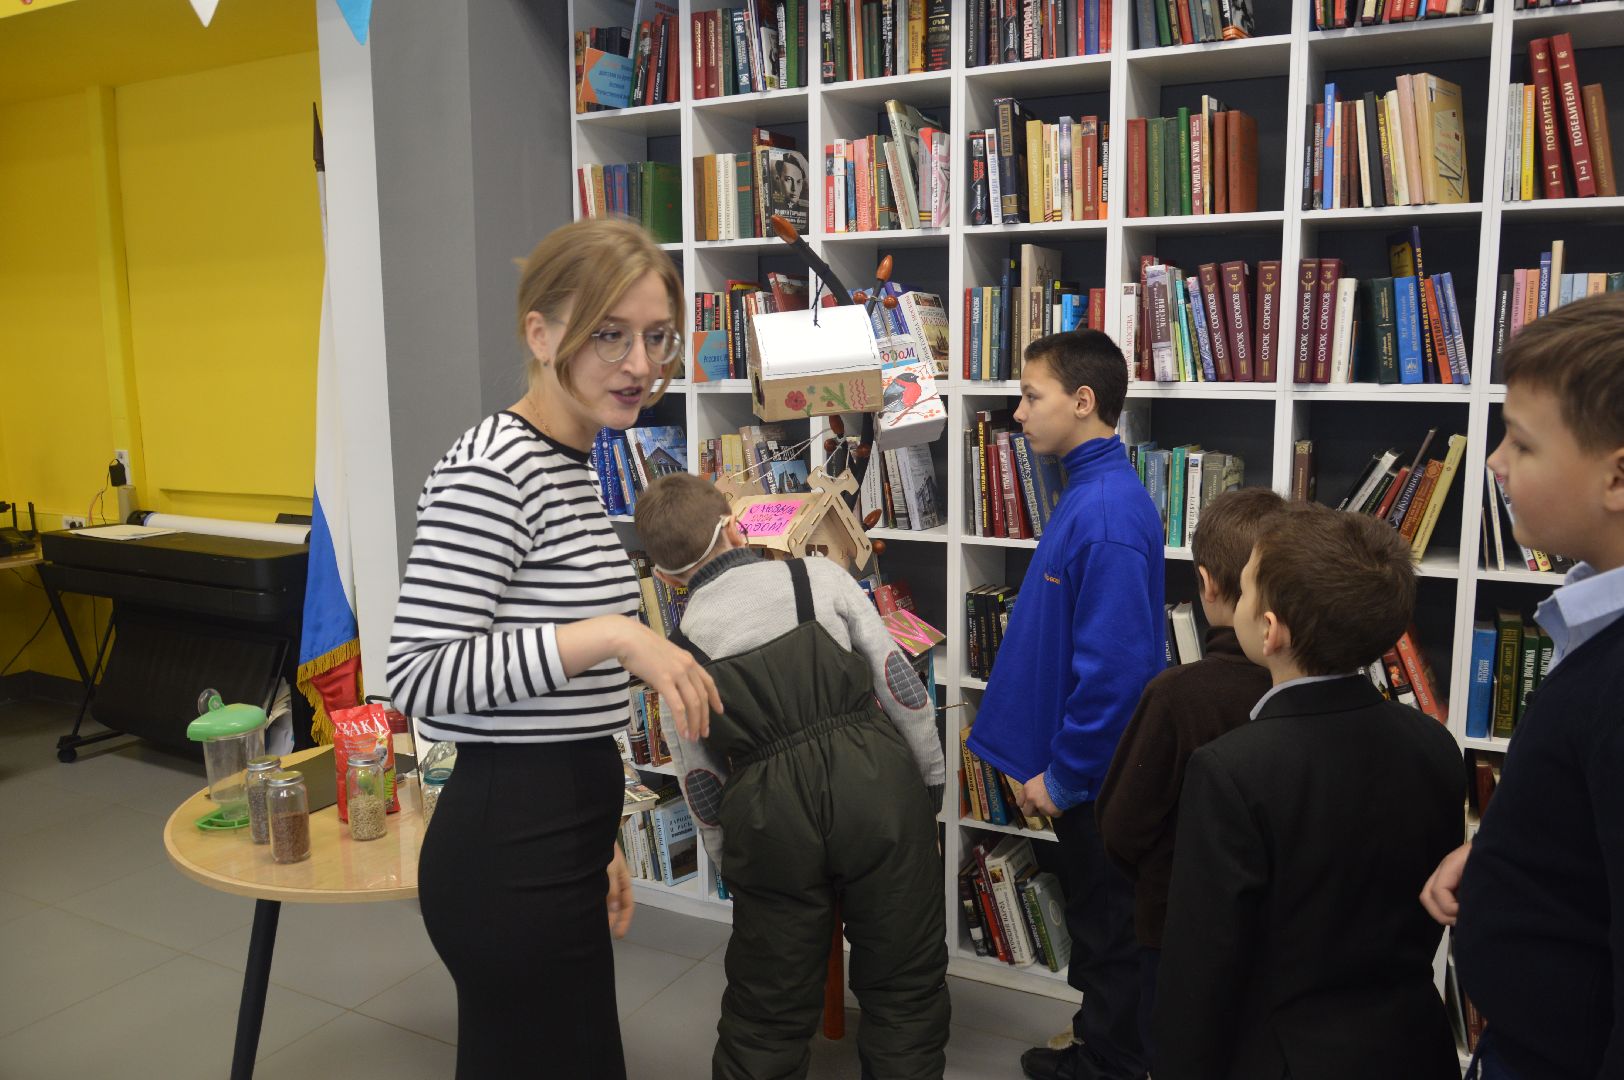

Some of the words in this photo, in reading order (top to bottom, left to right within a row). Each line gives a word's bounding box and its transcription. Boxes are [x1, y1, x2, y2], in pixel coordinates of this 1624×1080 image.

[1023, 6, 1033, 59] КАТАСТРОФА
[1540, 86, 1556, 151] ПОБЕДИТЕЛИ
[1563, 81, 1584, 147] ПОБЕДИТЕЛИ
[1192, 141, 1200, 163] ЖУКОВ
[1192, 165, 1201, 194] МАРШАЛ
[1551, 171, 1557, 180] 1
[1580, 166, 1587, 175] 2
[1209, 293, 1218, 329] СОРОКОВ
[1234, 293, 1242, 329] СОРОКОВ
[1263, 293, 1272, 330] СОРОКОВ
[1302, 292, 1312, 330] СОРОКОВ
[1320, 292, 1331, 330] СОРОКОВ
[1418, 271, 1429, 330] ВИДНОВСКОГО
[1539, 290, 1548, 308] ГОРОД
[1126, 314, 1134, 347] МОСКВА
[1213, 332, 1225, 359] СОРОК
[1237, 332, 1246, 359] СОРОК
[1262, 333, 1270, 361] СОРОК
[1300, 334, 1309, 361] СОРОК
[1318, 334, 1328, 362] СОРОК
[1424, 332, 1433, 363] АЗБУКА
[1447, 334, 1459, 375] БАЛАШИХА
[1457, 334, 1470, 376] БАЛАШИХА
[1524, 649, 1536, 678] ВОСТОКА
[964, 756, 975, 792] Археология
[1000, 900, 1009, 922] НАРОД
[1005, 923, 1016, 954] РУССКИЙ
